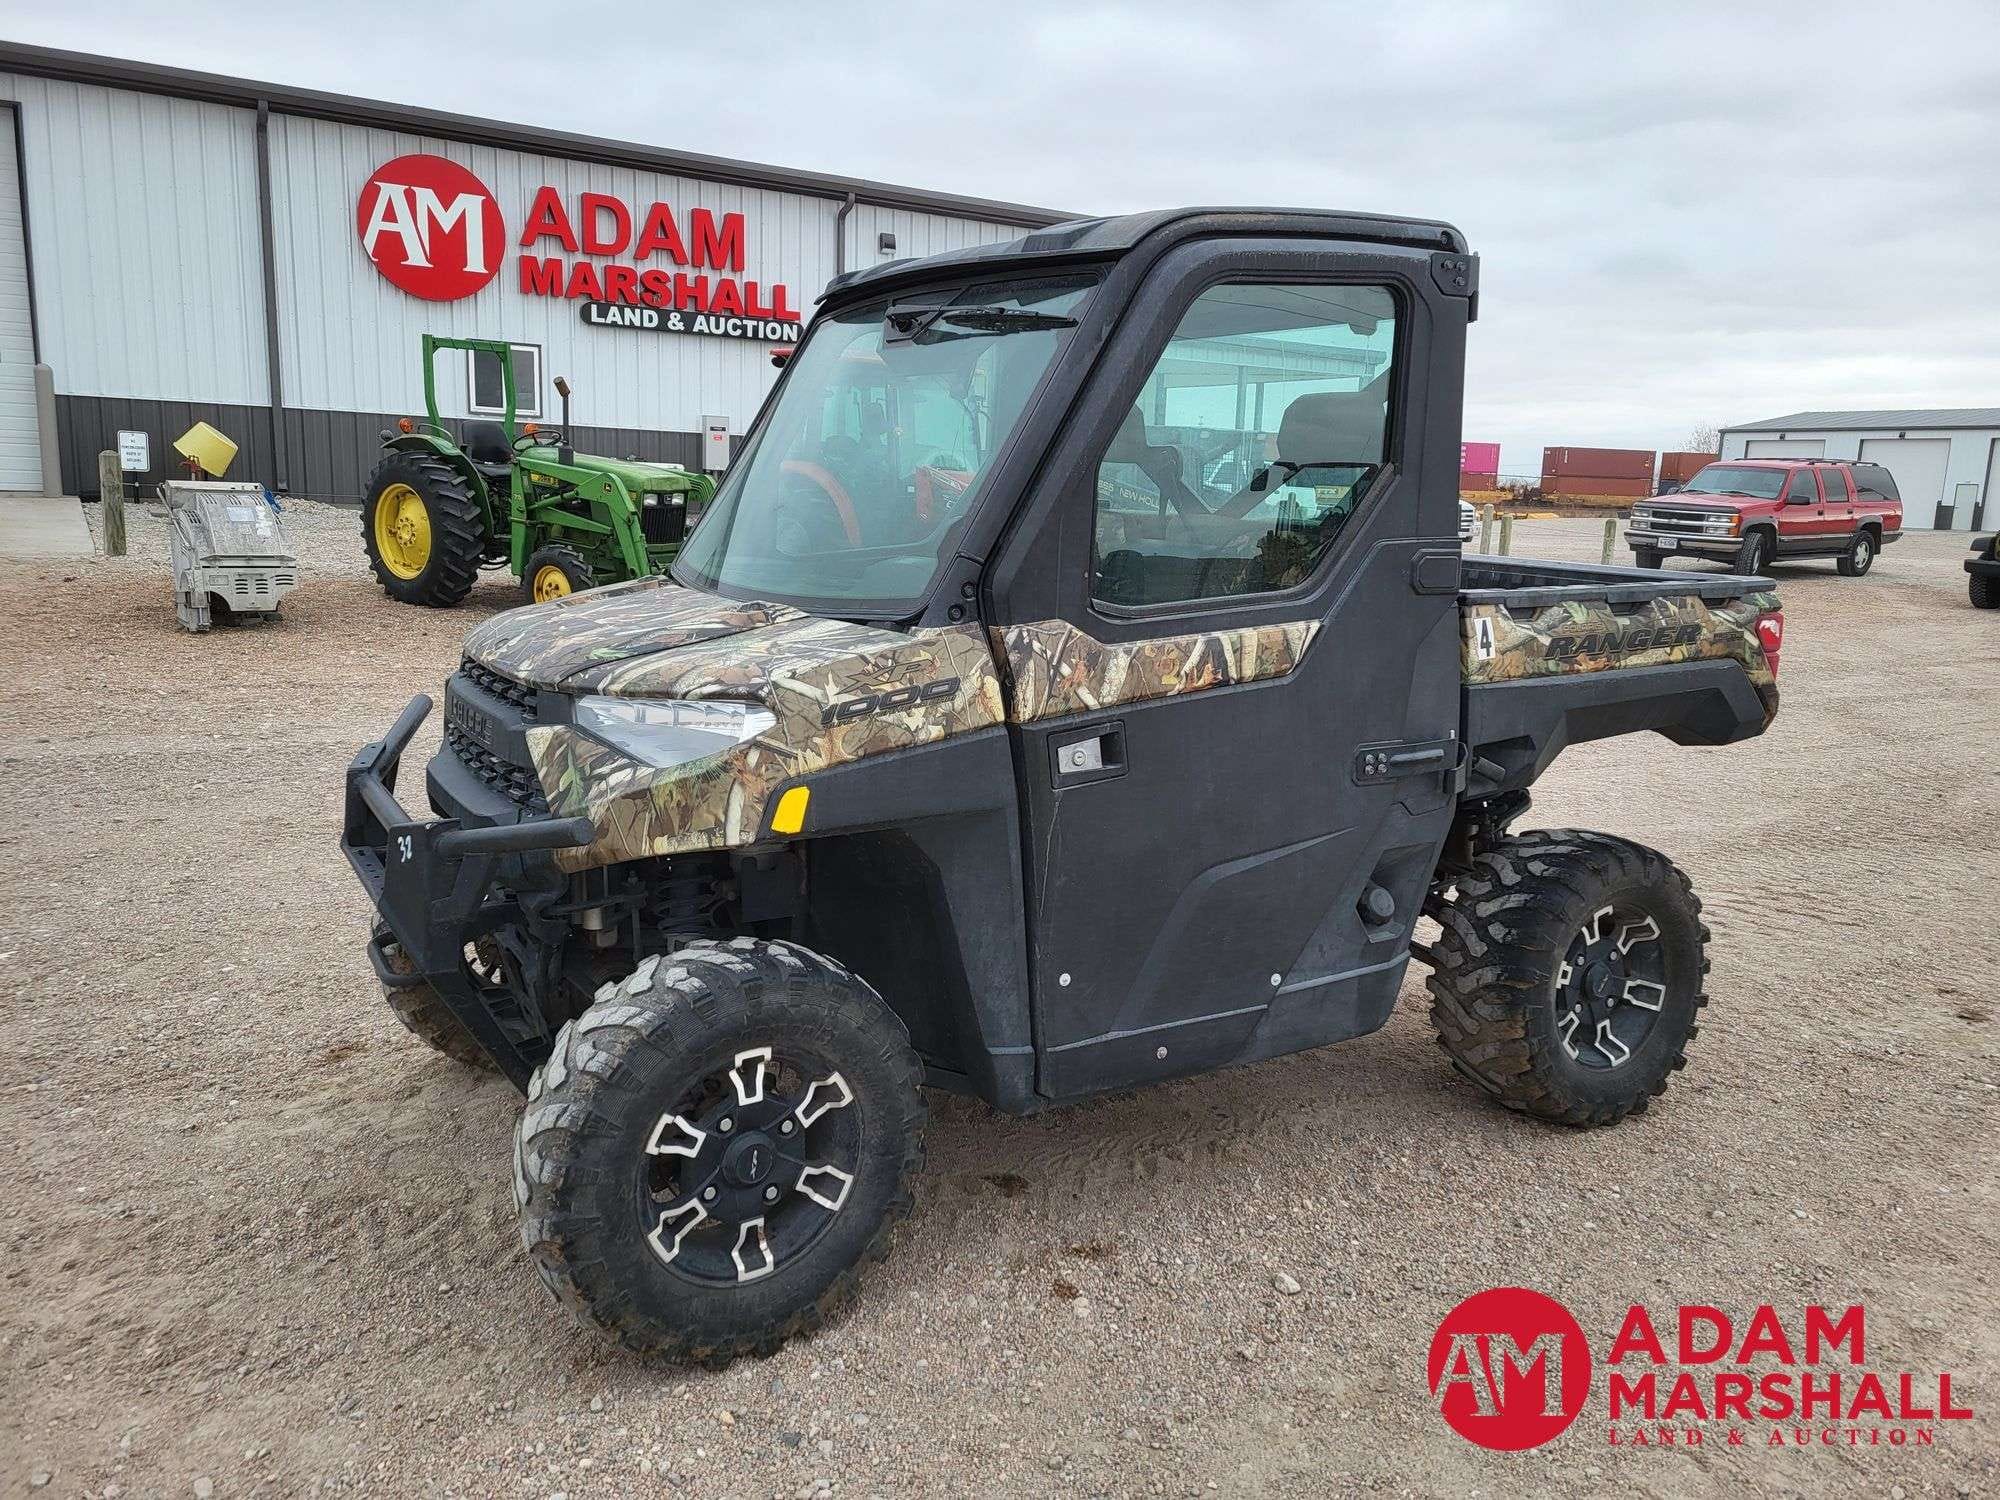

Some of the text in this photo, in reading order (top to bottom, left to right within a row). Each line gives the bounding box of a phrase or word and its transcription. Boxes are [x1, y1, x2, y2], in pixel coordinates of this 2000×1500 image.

[363, 181, 489, 274] AM
[519, 185, 745, 272] ADAM
[519, 254, 800, 321] MARSHALL
[590, 304, 799, 341] LAND & AUCTION
[1480, 619, 1492, 658] 4
[1544, 624, 1701, 660] RANGER
[834, 659, 934, 695] XP
[816, 677, 961, 725] 1000
